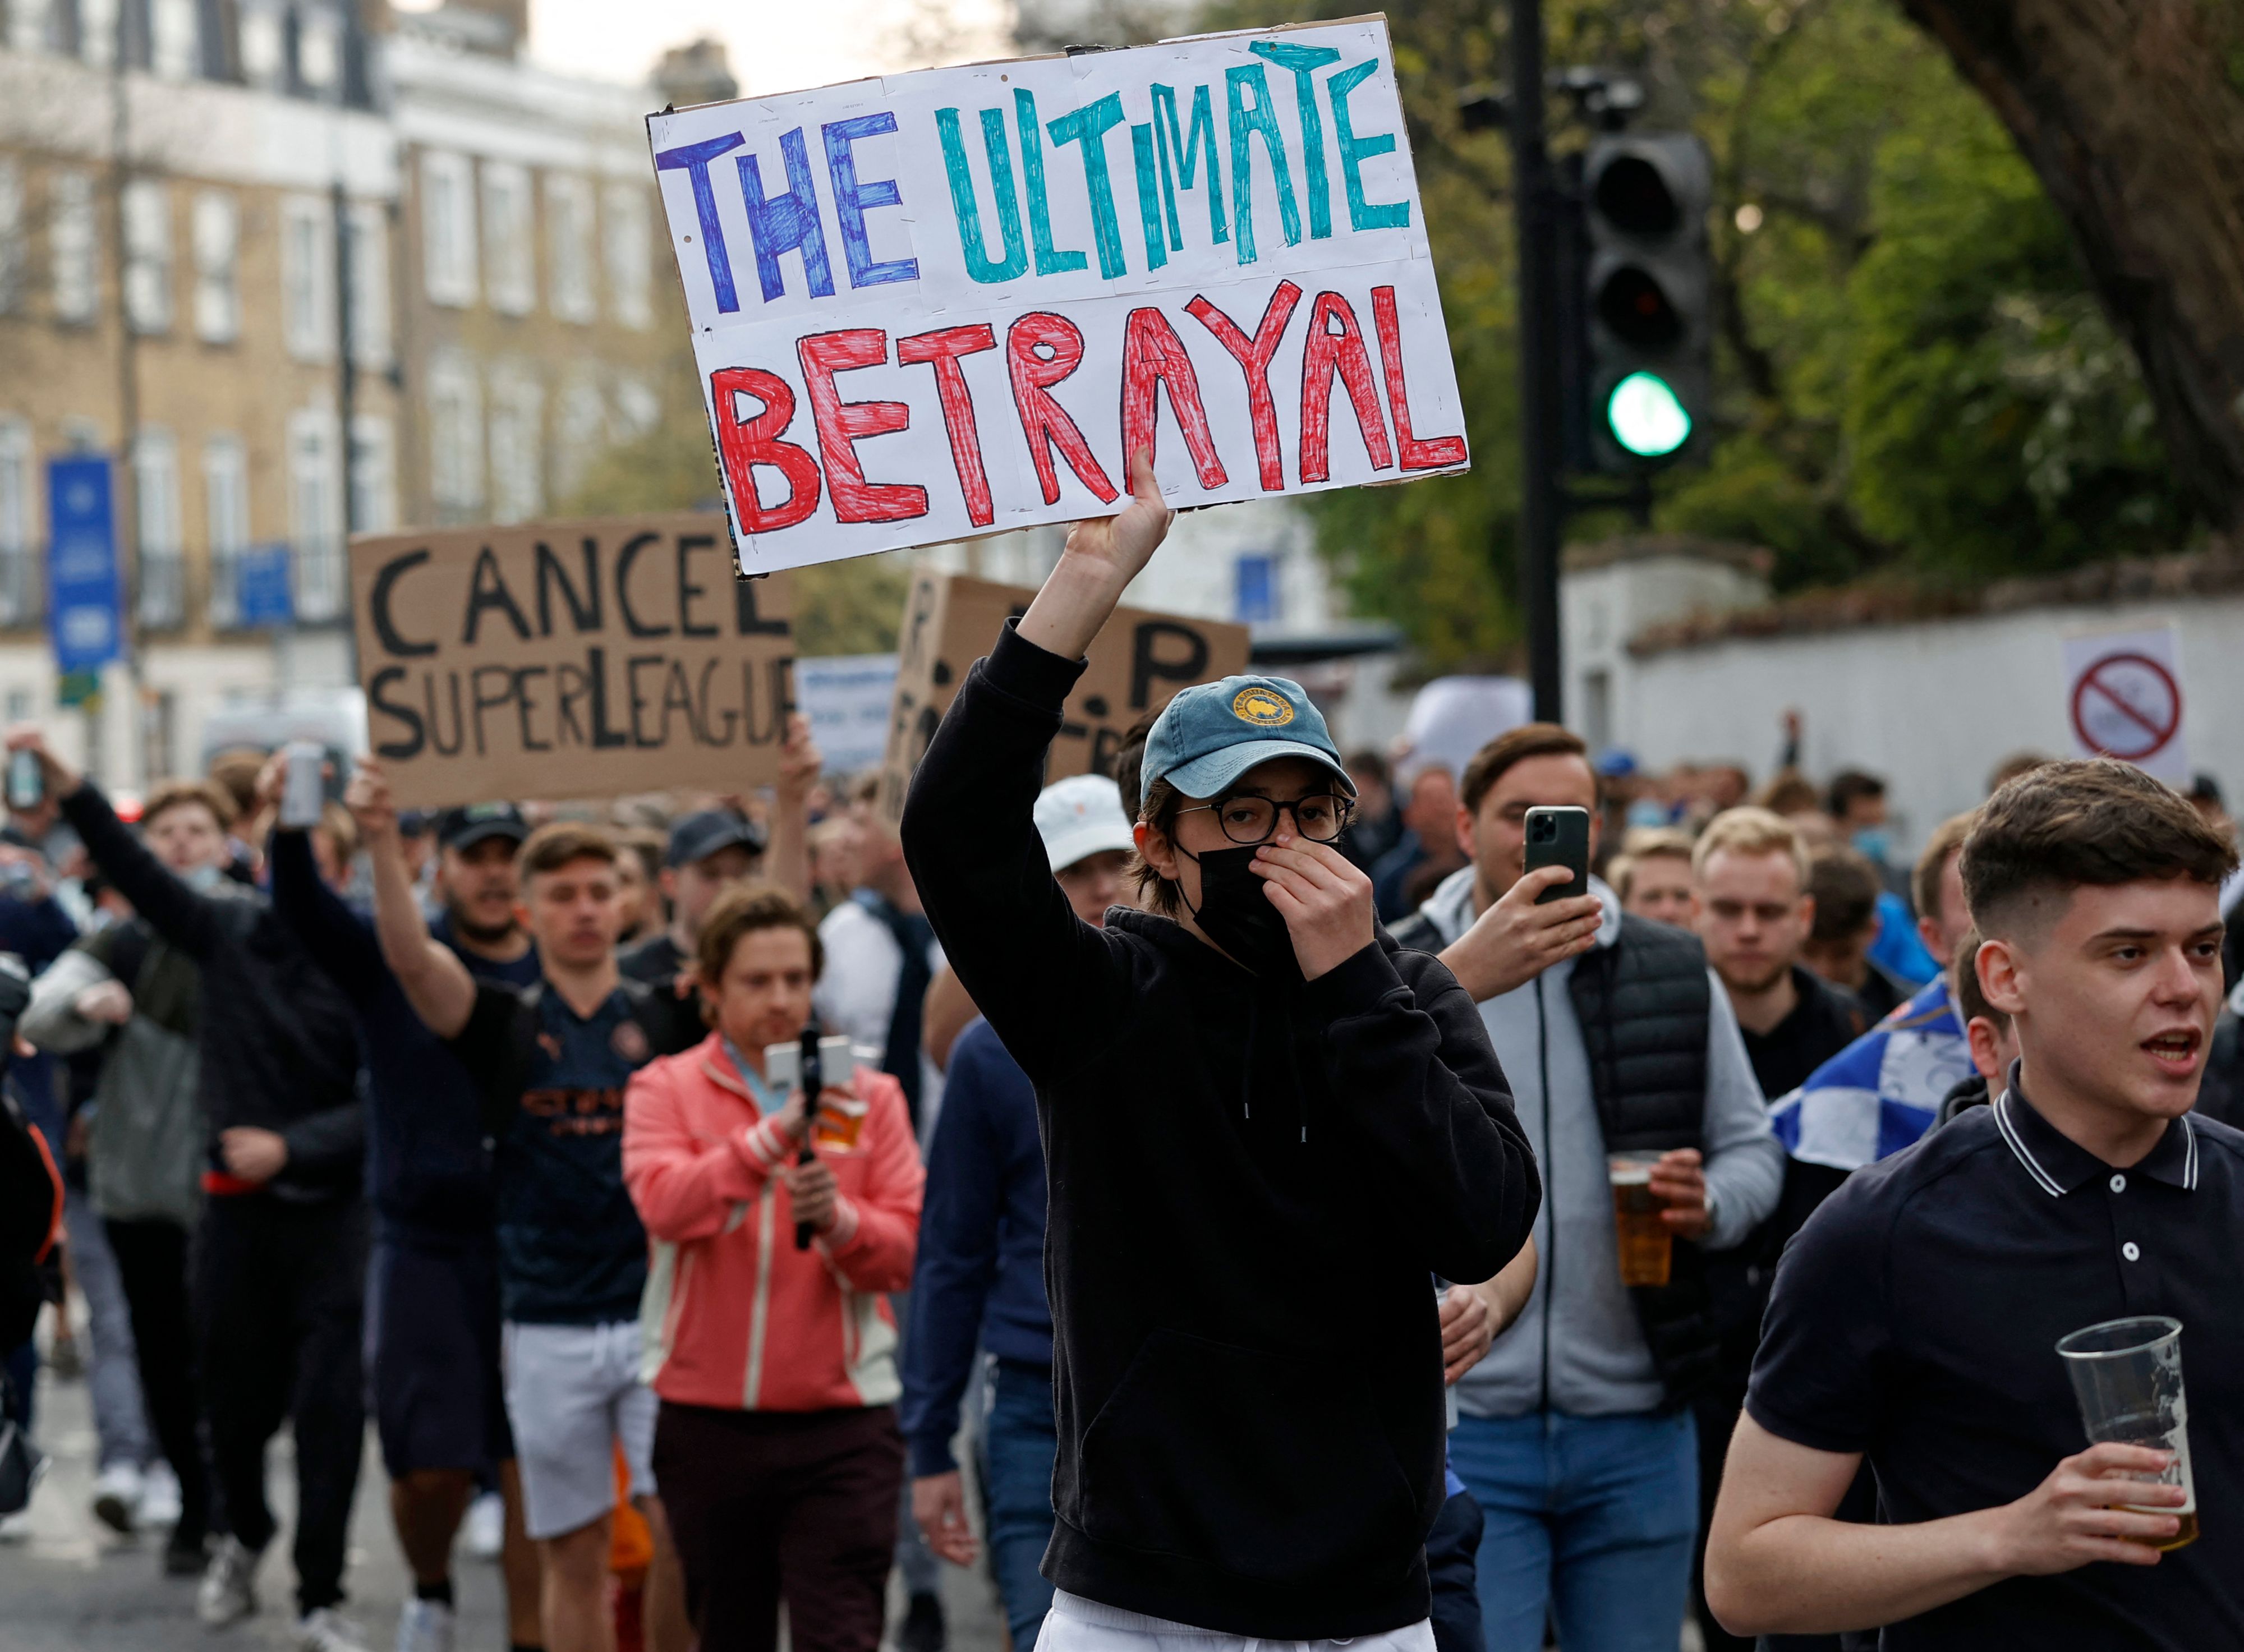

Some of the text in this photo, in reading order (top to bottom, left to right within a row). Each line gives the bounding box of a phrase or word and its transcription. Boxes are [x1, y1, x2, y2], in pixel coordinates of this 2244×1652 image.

[656, 39, 1410, 314] THE ULTIMATE
[710, 279, 1468, 535] BETRAYAL
[371, 532, 791, 656] CANCEL
